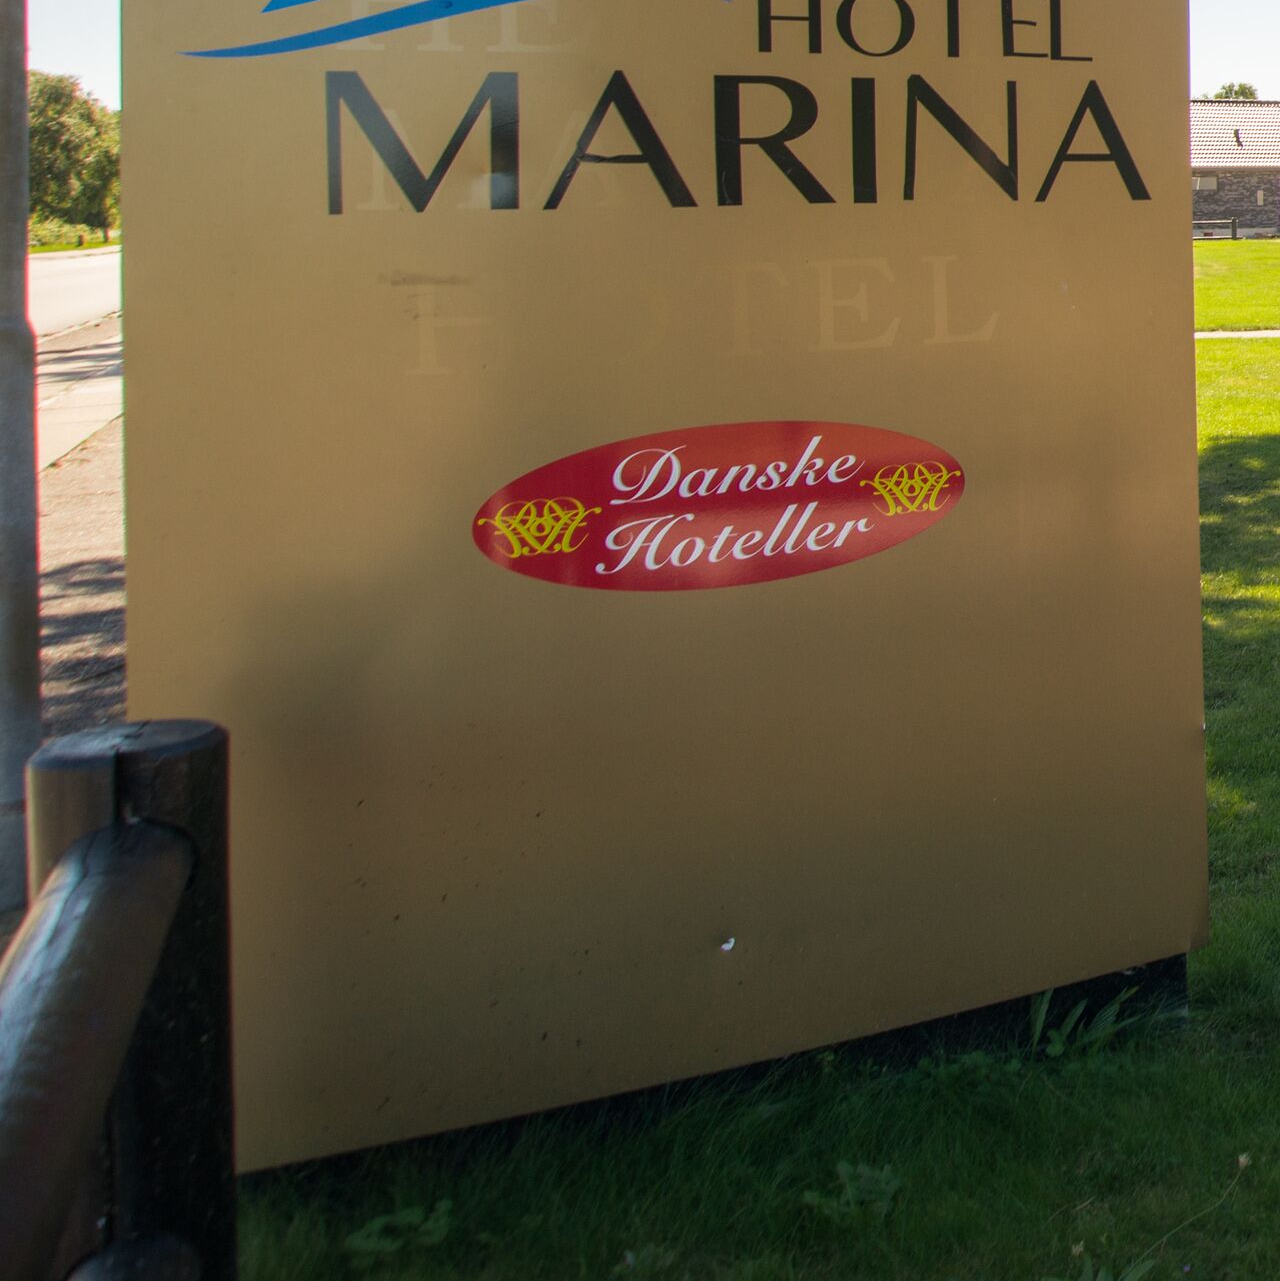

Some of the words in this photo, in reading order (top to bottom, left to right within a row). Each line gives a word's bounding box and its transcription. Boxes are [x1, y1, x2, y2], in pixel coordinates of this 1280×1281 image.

[326, 69, 1151, 216] MARINA
[609, 434, 866, 507] Danske
[594, 501, 874, 576] Hoteller
